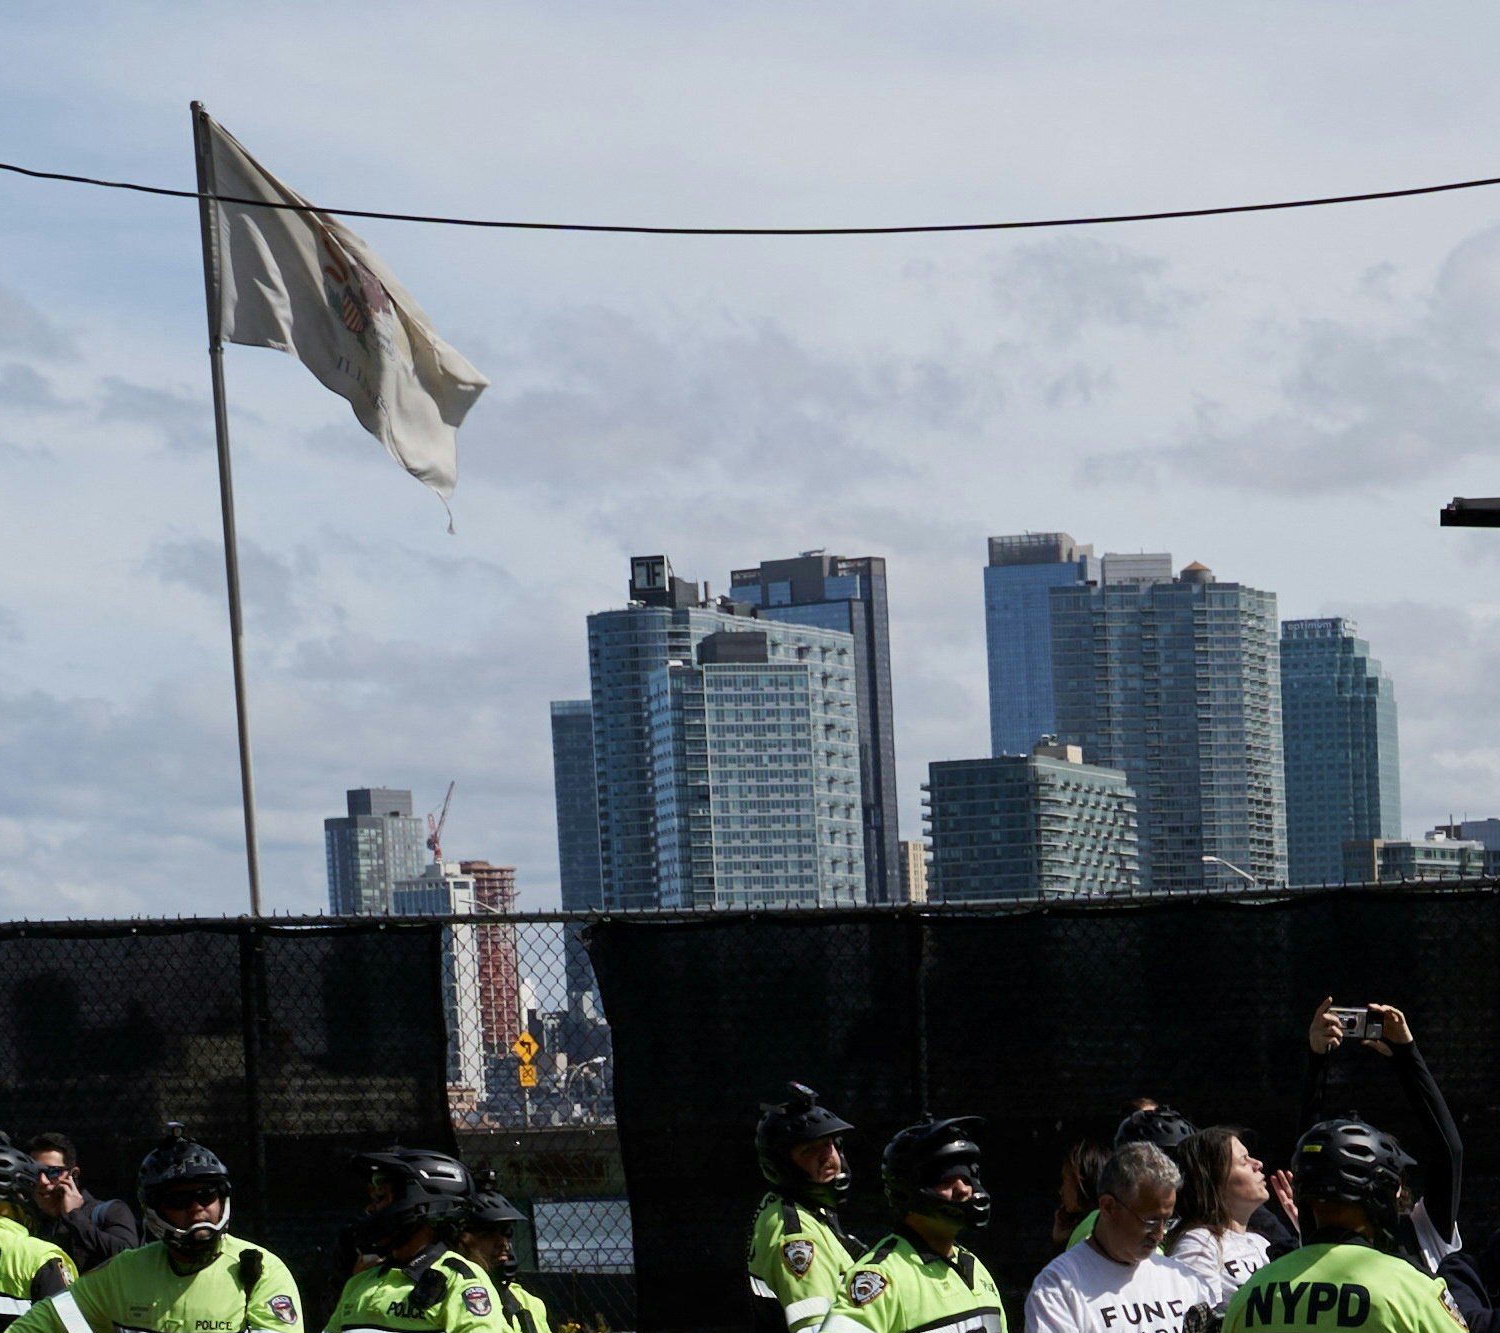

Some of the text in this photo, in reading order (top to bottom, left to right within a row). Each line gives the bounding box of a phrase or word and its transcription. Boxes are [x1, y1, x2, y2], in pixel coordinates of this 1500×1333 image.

[1225, 1260, 1258, 1279] FU
[1245, 1281, 1371, 1329] NYPD
[195, 1320, 233, 1332] POLICE
